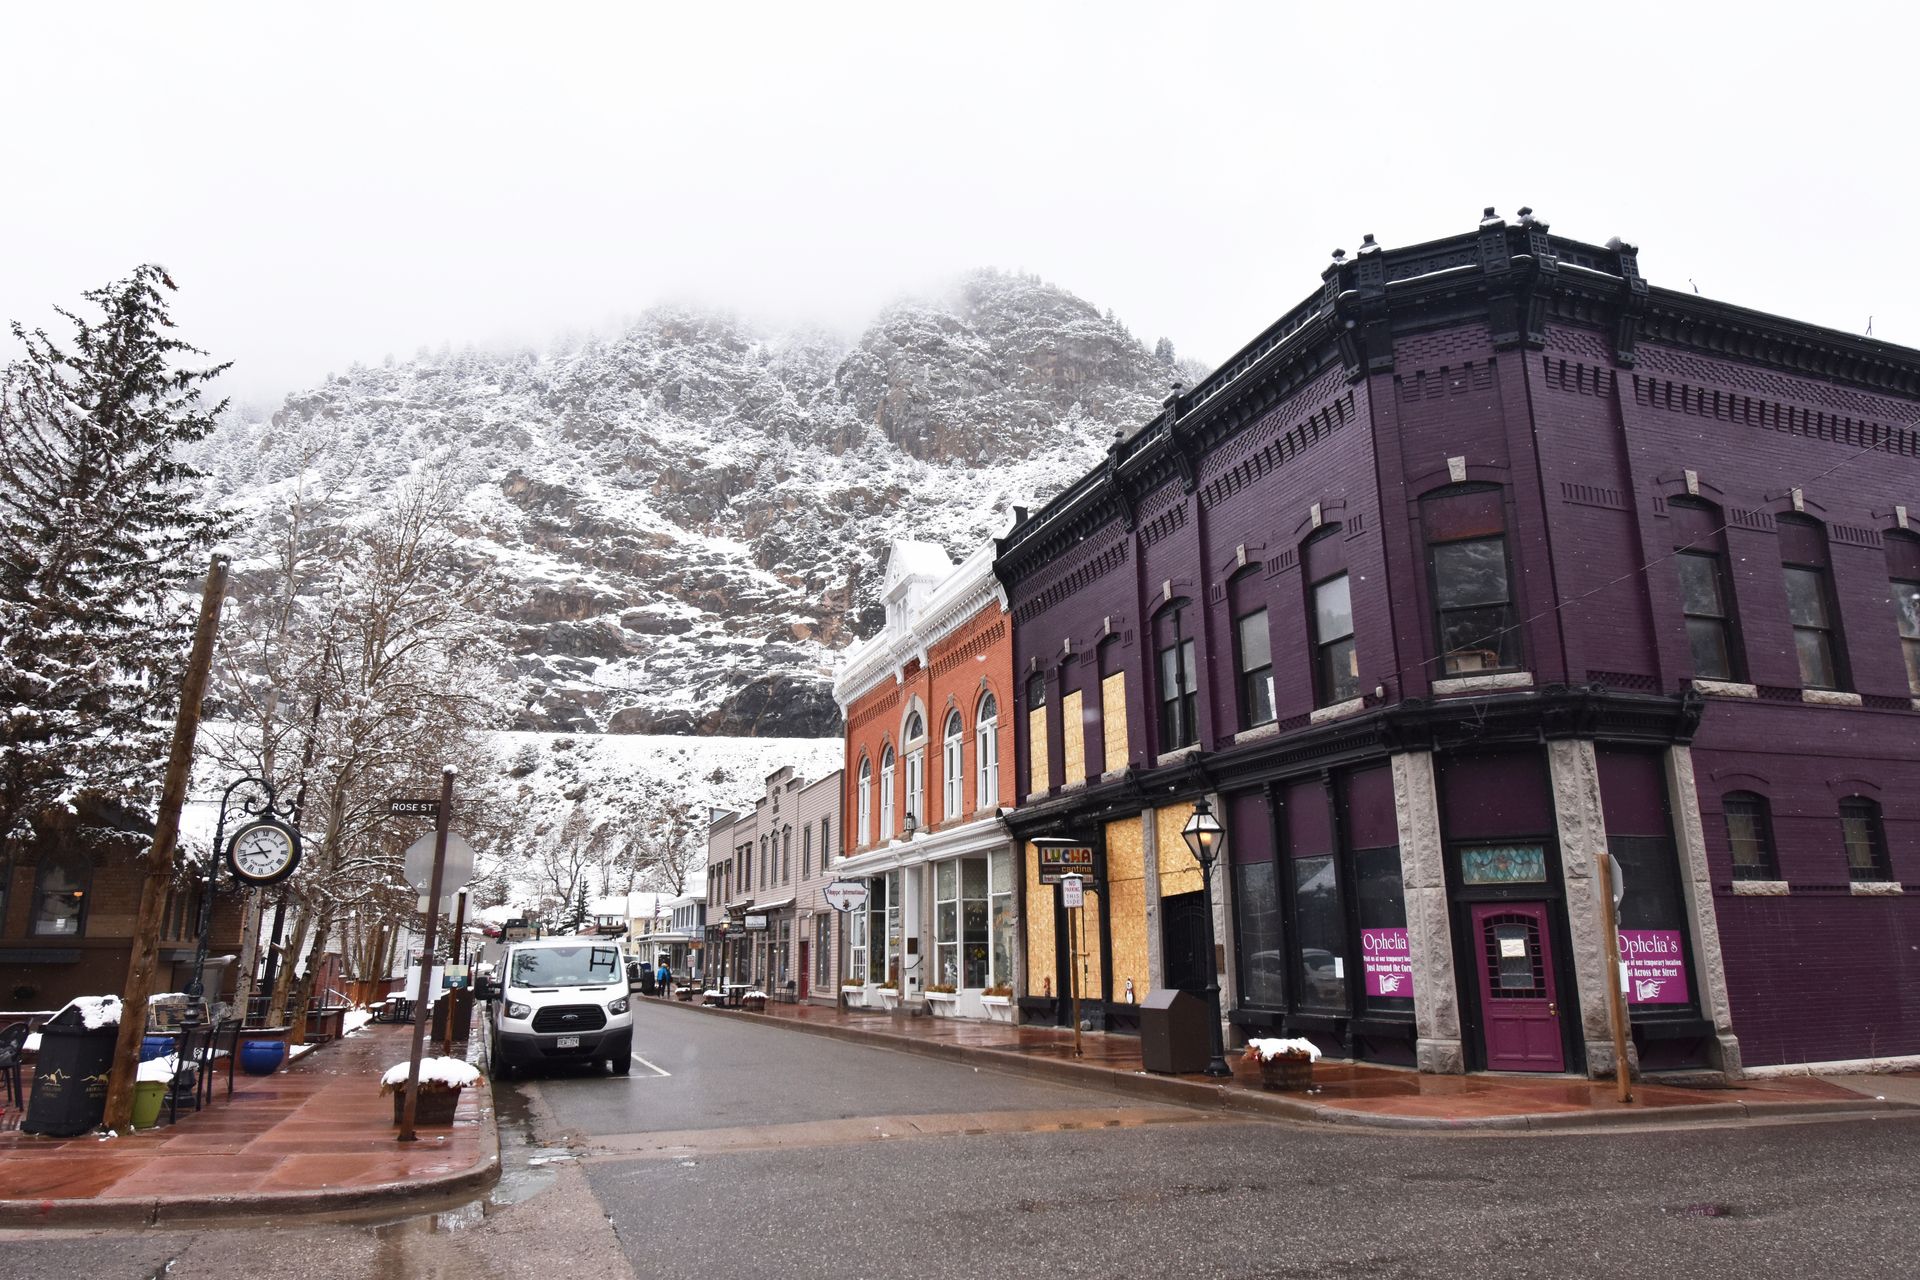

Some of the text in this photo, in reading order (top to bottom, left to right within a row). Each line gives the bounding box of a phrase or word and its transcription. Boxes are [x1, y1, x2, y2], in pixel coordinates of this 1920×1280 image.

[392, 803, 418, 811] ROSE
[1044, 849, 1091, 863] LUCHA
[1061, 865, 1092, 873] cantina
[1363, 932, 1409, 956] Ophelia'
[1618, 934, 1678, 959] Ophelia's
[1376, 963, 1393, 972] Around
[1393, 964, 1401, 972] the
[1401, 963, 1412, 972] Corn
[1634, 968, 1651, 976] Across
[1652, 968, 1661, 977] the
[1662, 968, 1677, 976] Street
